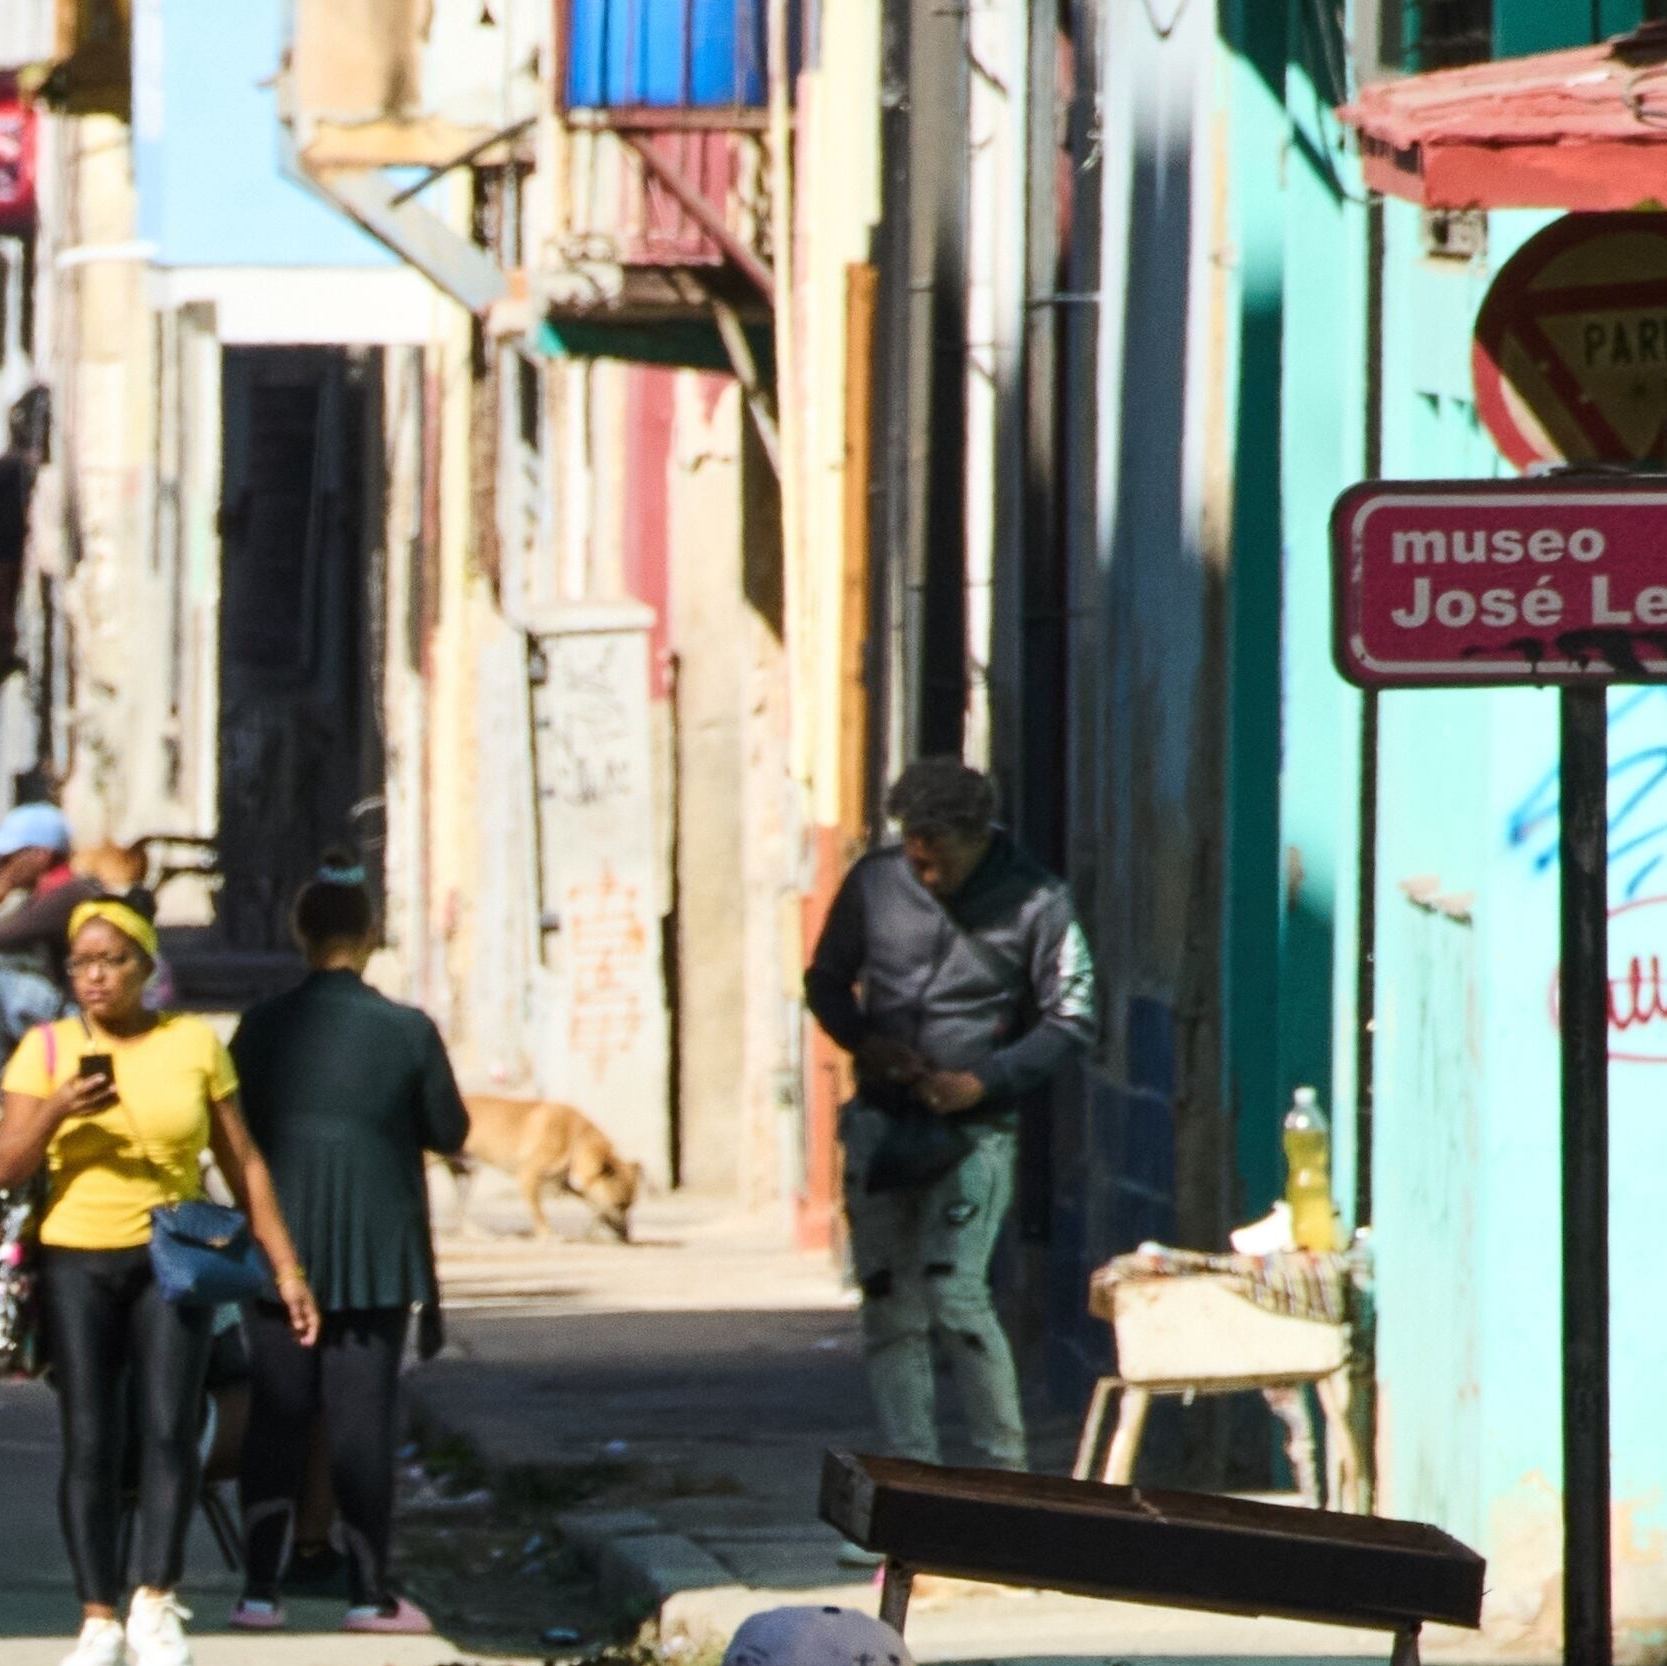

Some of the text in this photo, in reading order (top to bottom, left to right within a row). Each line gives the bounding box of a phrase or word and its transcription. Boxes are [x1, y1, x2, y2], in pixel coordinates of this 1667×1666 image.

[1585, 319, 1667, 367] PAR
[1390, 527, 1606, 564] museo
[1390, 574, 1667, 629] José Le
